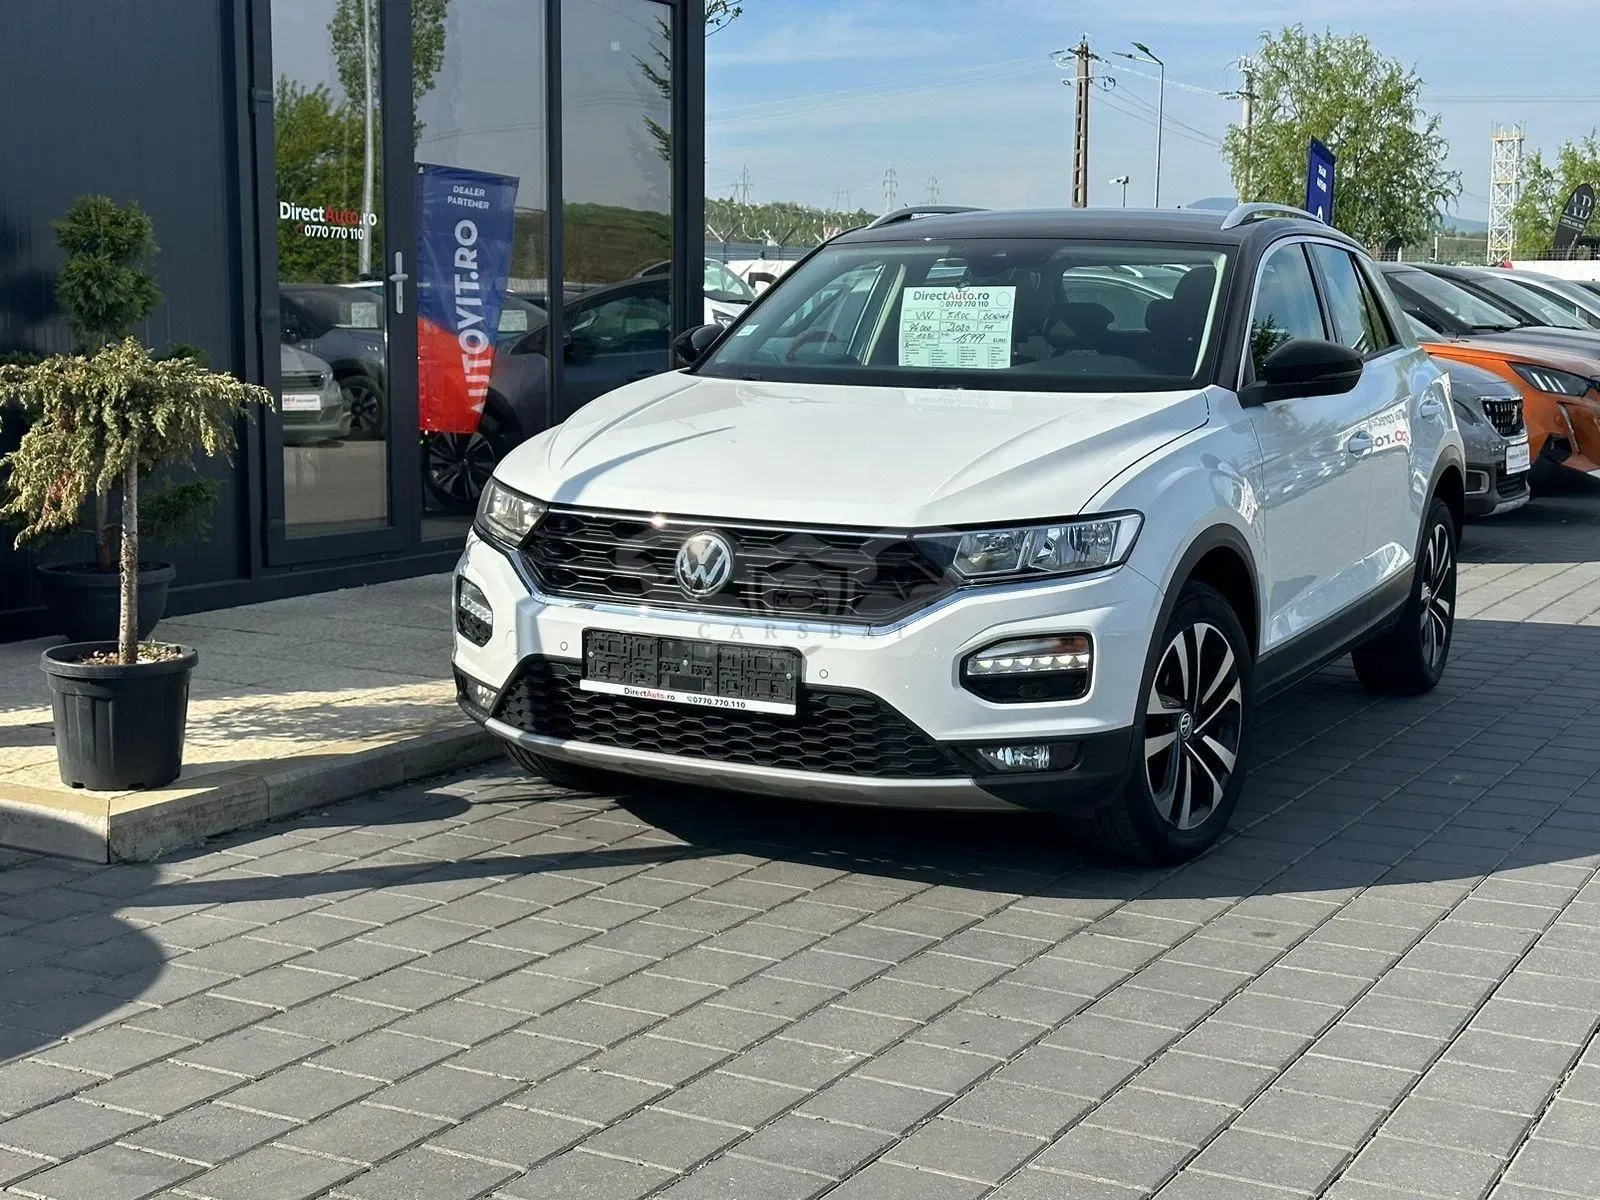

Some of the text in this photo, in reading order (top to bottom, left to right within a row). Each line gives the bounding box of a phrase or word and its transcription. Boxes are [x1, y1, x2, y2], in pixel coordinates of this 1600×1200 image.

[453, 185, 486, 197] DEALER
[447, 195, 490, 210] PARTENER
[280, 201, 377, 226] DirectAuto.ro
[304, 224, 364, 240] 0770 770 110
[913, 290, 990, 301] DirectAuto.ro
[624, 687, 675, 701] DirectAuto.ro
